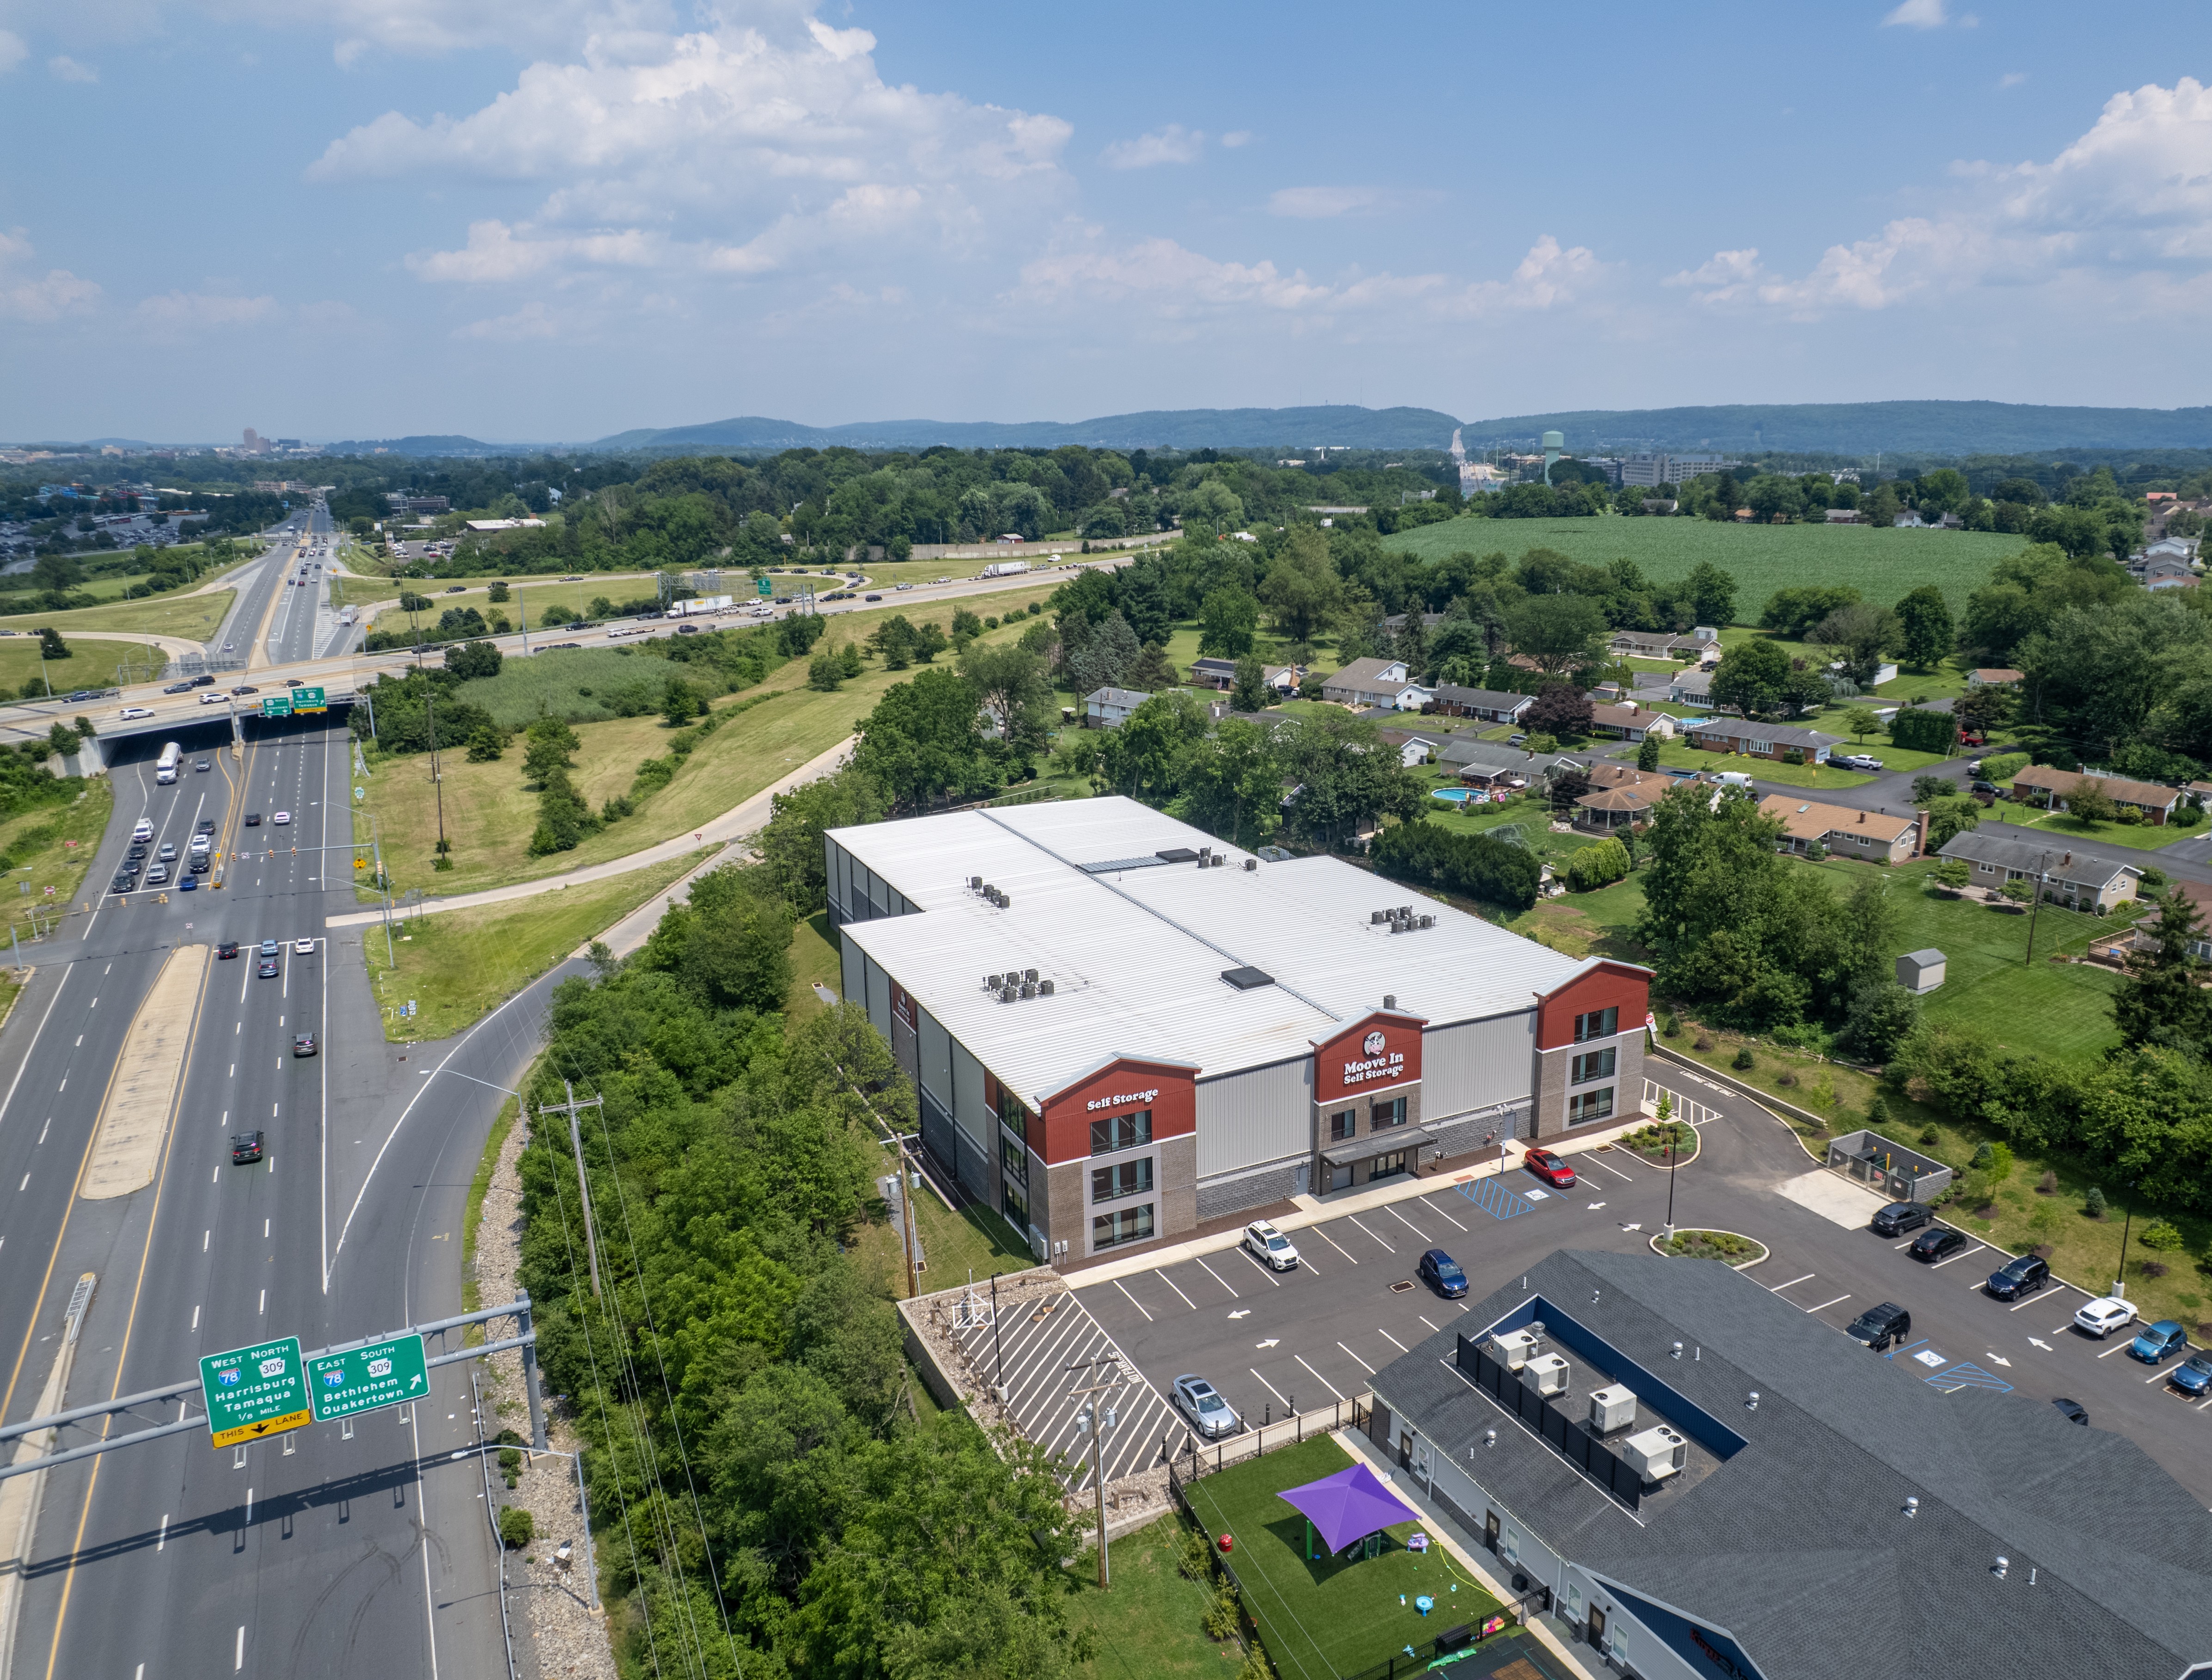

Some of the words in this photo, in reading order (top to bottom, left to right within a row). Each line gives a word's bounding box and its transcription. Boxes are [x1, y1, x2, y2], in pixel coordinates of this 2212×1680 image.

[1344, 1057, 1386, 1075] Moove
[1389, 1052, 1404, 1064] In
[1344, 1073, 1364, 1085] Self
[1365, 1064, 1404, 1079] Storage
[1679, 1071, 1706, 1083] LOADING
[1704, 1082, 1723, 1091] ZONE
[1719, 1089, 1737, 1097] ONLY
[1087, 1097, 1111, 1110] Self
[1112, 1089, 1158, 1103] Storage
[211, 1355, 243, 1369] WEST
[251, 1345, 289, 1360] NORTH
[262, 1361, 283, 1374] 309
[317, 1358, 346, 1371] EAST
[360, 1346, 395, 1360] SOUTH
[370, 1361, 390, 1374] 309
[215, 1376, 296, 1402] Harrisburg
[221, 1372, 238, 1384] 78
[324, 1377, 398, 1402] Bethlehem
[325, 1374, 342, 1385] 78
[1127, 1373, 1143, 1384] NO
[224, 1390, 291, 1413] Tamaqua
[323, 1388, 403, 1415] Quakertown
[238, 1412, 253, 1422] 1/8
[260, 1405, 281, 1416] MILE
[220, 1428, 244, 1440] THIS
[275, 1413, 303, 1425] LANE
